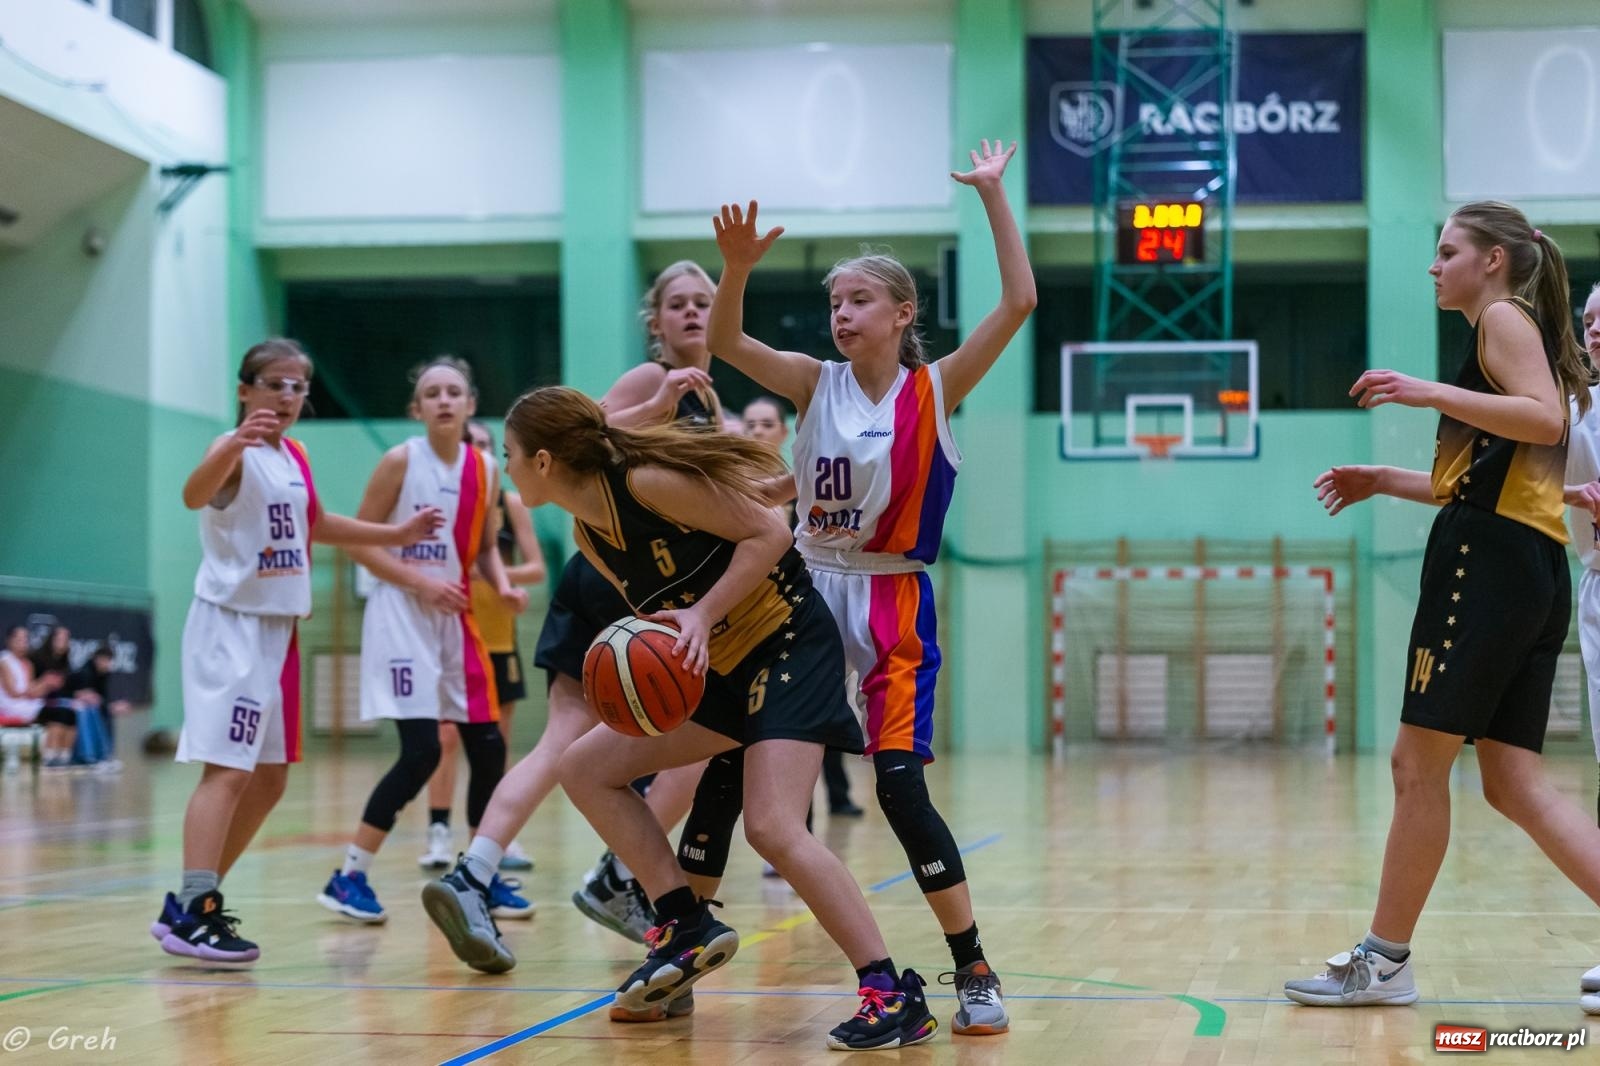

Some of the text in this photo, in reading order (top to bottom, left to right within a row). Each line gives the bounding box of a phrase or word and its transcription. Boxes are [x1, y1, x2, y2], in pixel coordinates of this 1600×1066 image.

[1136, 228, 1186, 262] 24
[815, 456, 852, 501] 20
[268, 503, 295, 540] 55
[650, 538, 677, 577] 5
[390, 667, 412, 698] 16
[1410, 648, 1435, 694] 14
[748, 668, 769, 715] 5
[229, 705, 261, 746] 55
[688, 846, 705, 862] NBA
[926, 859, 946, 876] NBA
